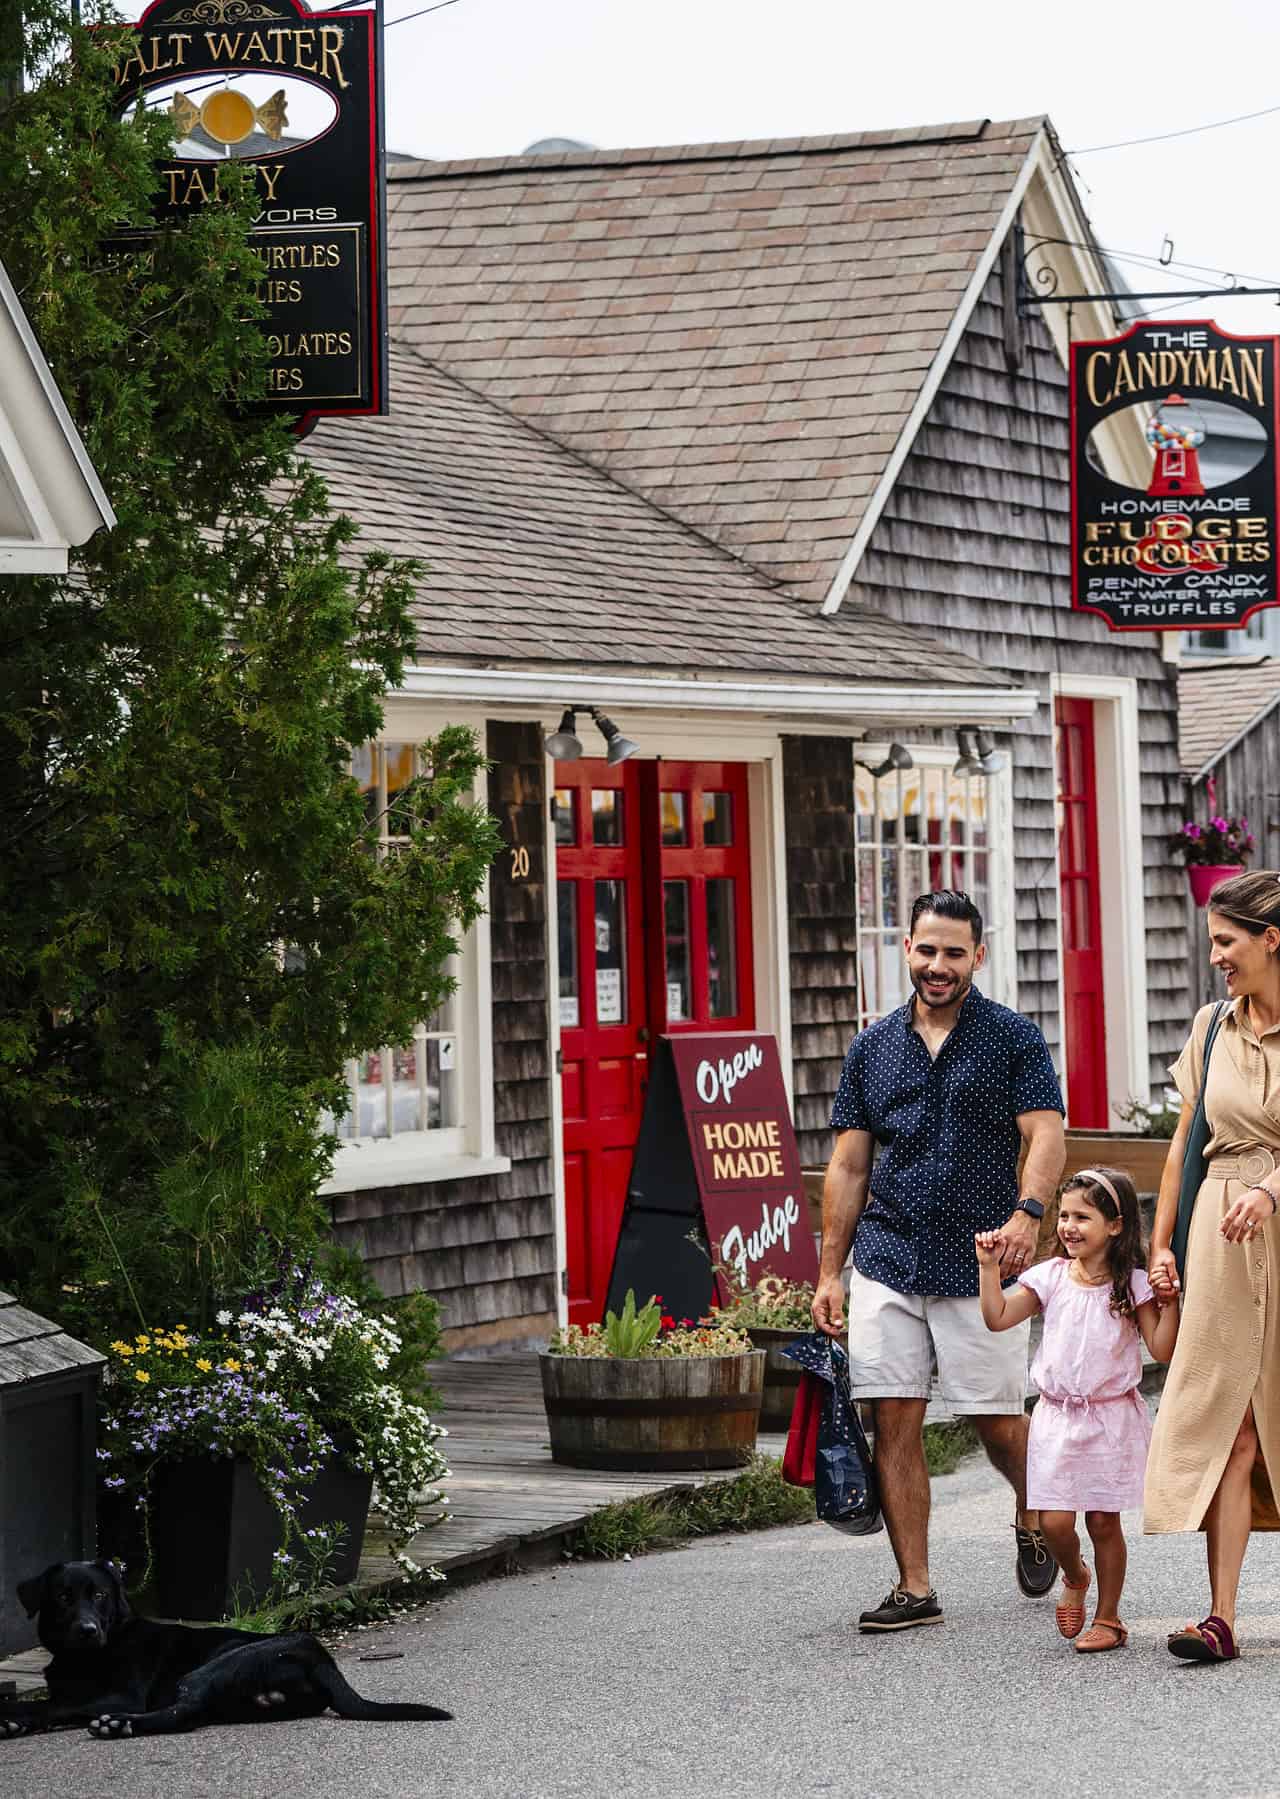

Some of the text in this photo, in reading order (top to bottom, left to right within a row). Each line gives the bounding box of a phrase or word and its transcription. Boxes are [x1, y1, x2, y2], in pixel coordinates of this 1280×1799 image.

[112, 26, 351, 88] ALT WATER
[251, 244, 341, 269] URTLES
[1145, 331, 1208, 348] THE
[1086, 347, 1265, 408] CANDYMAN
[1101, 498, 1251, 515] HOMEMADE
[1085, 517, 1268, 542] FUDGE
[1083, 542, 1271, 567] CHOCOLATES
[1088, 574, 1267, 590] PENNY CANDY
[1086, 588, 1268, 603] SALT WATER TAFFY
[1119, 602, 1236, 617] TRUFFLES
[510, 846, 530, 880] 20
[696, 1043, 763, 1104] Open
[703, 1121, 781, 1150] HOME
[713, 1151, 785, 1180] MADE
[722, 1195, 800, 1288] Fudge
